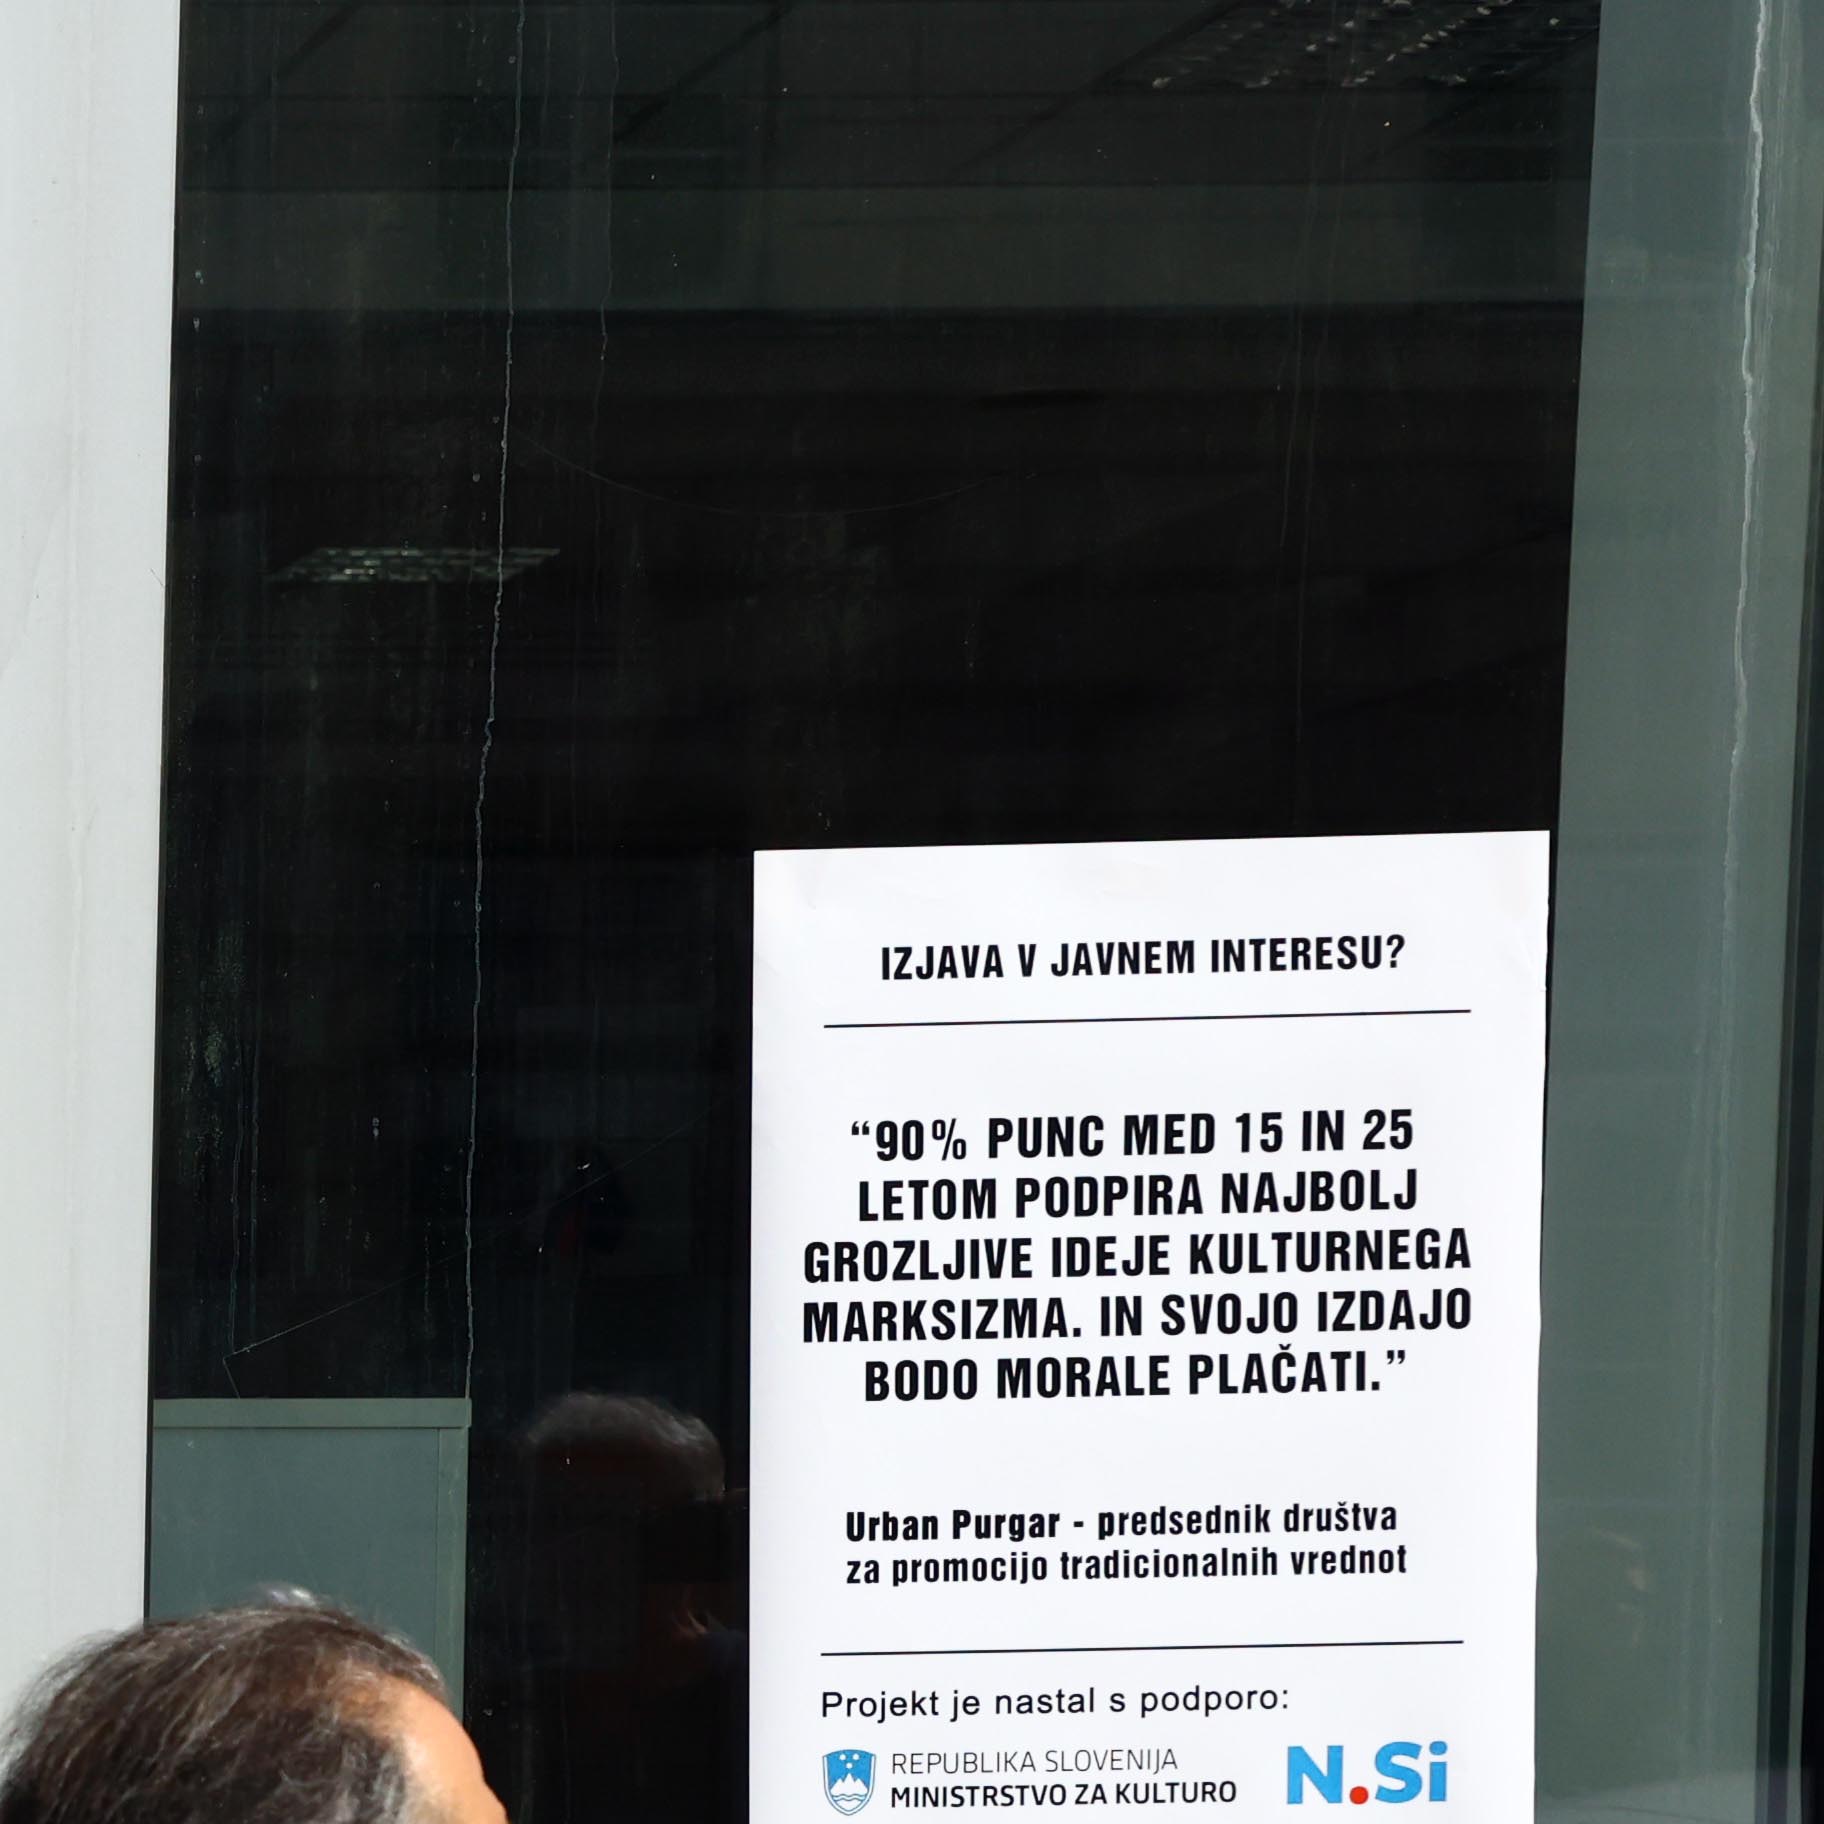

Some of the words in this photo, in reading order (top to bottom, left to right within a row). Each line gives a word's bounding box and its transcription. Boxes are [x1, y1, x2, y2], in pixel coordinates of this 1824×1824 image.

[881, 944, 1005, 981] IZJAVA
[1017, 943, 1037, 978] V
[1050, 939, 1195, 978] JAVNEM
[1210, 933, 1406, 974] INTERESU?
[987, 1114, 1105, 1160] PUNC
[1123, 1112, 1216, 1157] MED
[1235, 1111, 1284, 1154] 15
[1301, 1109, 1345, 1152] IN
[1361, 1108, 1414, 1151] 25
[858, 1177, 997, 1222] LETOM
[1015, 1173, 1204, 1219] PODPIRA
[1220, 1167, 1418, 1215] NAJBOLJ
[803, 1237, 1033, 1284] GROZLJIVE
[1051, 1234, 1171, 1278] IDEJE
[1189, 1227, 1472, 1275] KULTURNEGA
[802, 1296, 1082, 1344] MARKSIZMA.
[1100, 1295, 1143, 1337] IN
[1160, 1291, 1299, 1337] SVOJO
[1317, 1287, 1472, 1333] IZDAJO
[864, 1358, 978, 1402] BODO
[996, 1354, 1171, 1400] MORALE
[846, 1510, 939, 1543] Urban
[952, 1509, 1061, 1543] Purgar
[1097, 1503, 1272, 1541] predsednik
[1283, 1500, 1397, 1533] društva
[846, 1559, 880, 1585] za
[892, 1551, 1048, 1588] promocijo
[1059, 1546, 1278, 1581] tradicionalnih
[1290, 1544, 1407, 1576] vrednot
[821, 1689, 940, 1725] Projekt
[949, 1689, 981, 1723] je
[995, 1686, 1095, 1715] nastal
[1109, 1692, 1126, 1713] s
[1140, 1684, 1288, 1719] podporo:
[892, 1751, 1037, 1775] REPUBLIKA
[1045, 1748, 1178, 1775] SLOVENIJA
[891, 1783, 1067, 1809] MINISTRSTVO
[1074, 1783, 1108, 1806] ZA
[1115, 1780, 1237, 1805] KULTURO
